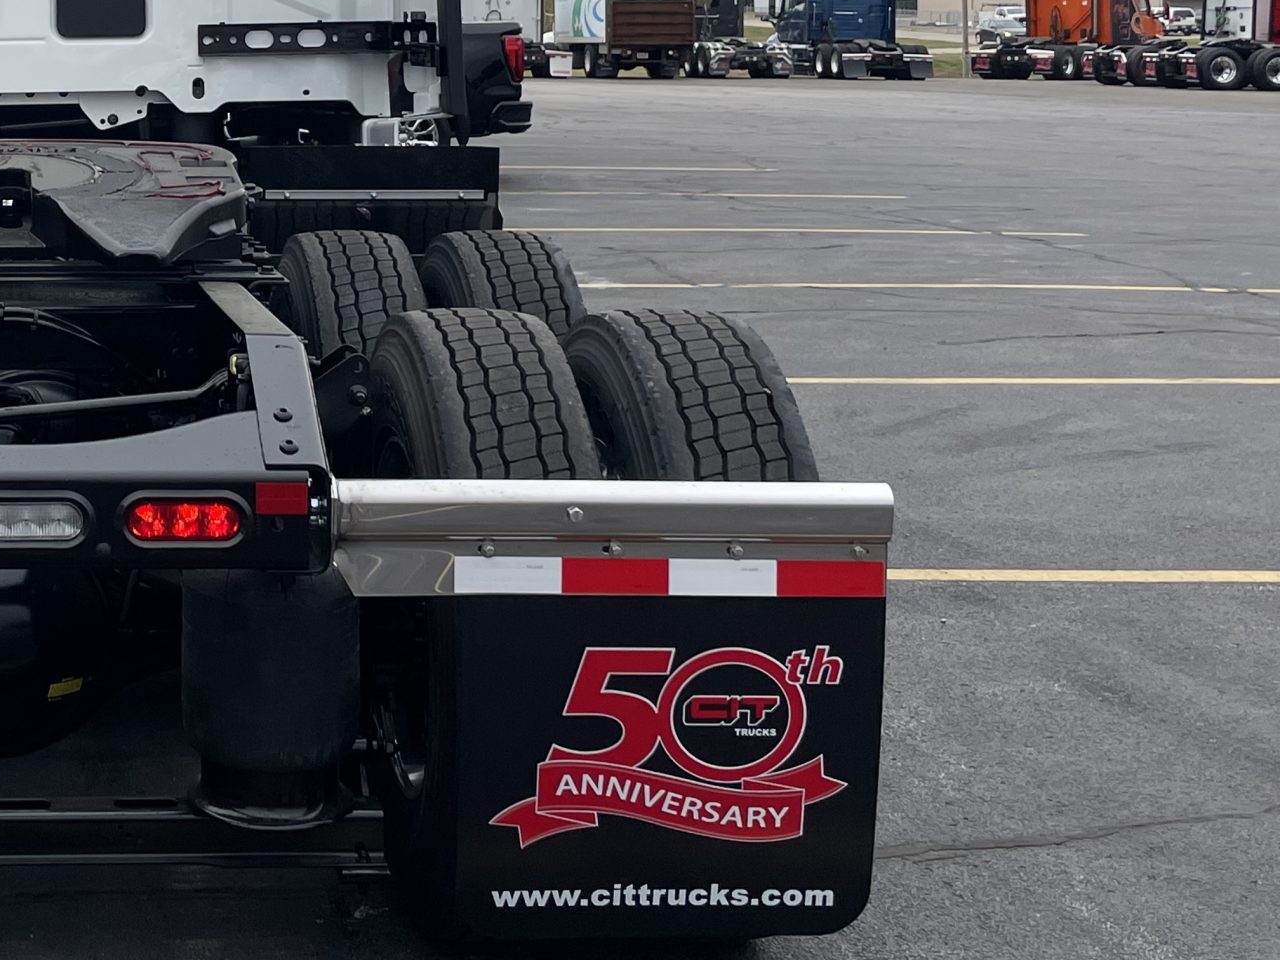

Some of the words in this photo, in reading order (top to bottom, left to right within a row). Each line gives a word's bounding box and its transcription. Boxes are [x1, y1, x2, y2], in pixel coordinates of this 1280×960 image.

[684, 696, 780, 726] CIT
[735, 728, 776, 737] TRUCKS
[556, 774, 789, 828] ANNIVERSARY
[492, 884, 834, 907] www.cittrucks.com
